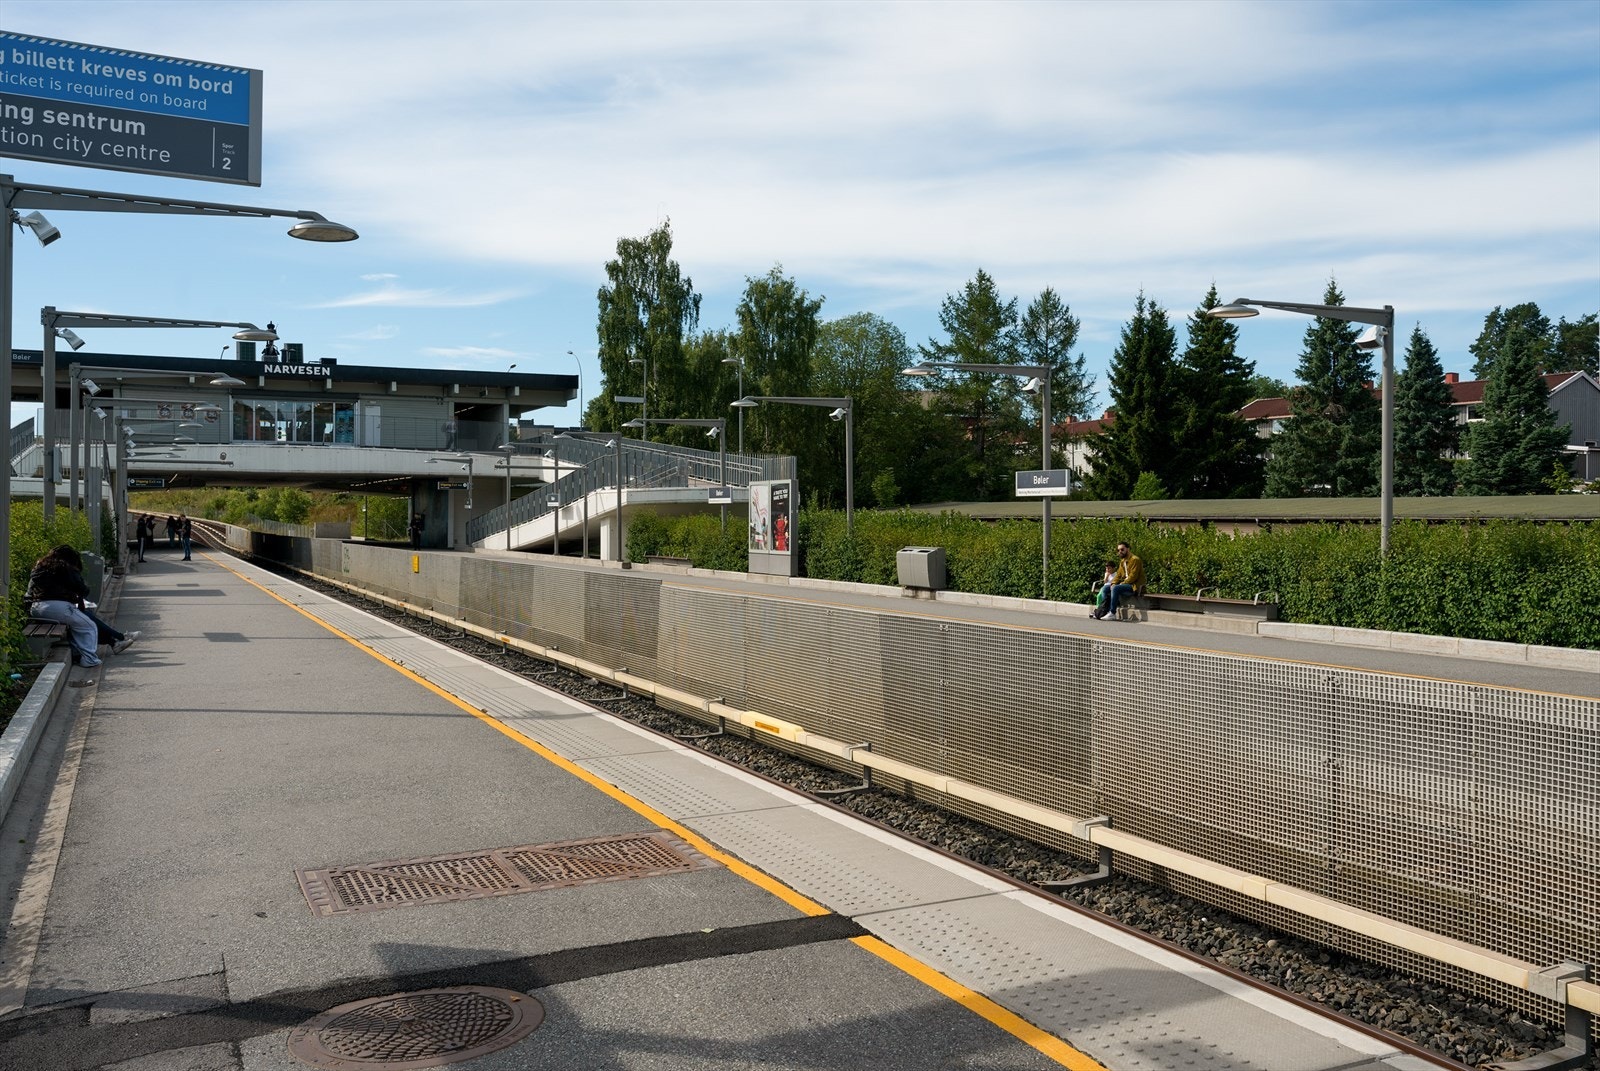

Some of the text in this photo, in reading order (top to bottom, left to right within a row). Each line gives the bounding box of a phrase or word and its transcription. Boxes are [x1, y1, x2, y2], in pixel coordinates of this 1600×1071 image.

[12, 48, 75, 72] billett
[81, 59, 147, 82] kreves
[153, 72, 182, 88] om
[188, 74, 233, 94] bord
[0, 70, 207, 111] ticket is required on board
[42, 109, 146, 136] sentrum
[1, 126, 170, 163] tion city centre
[222, 157, 231, 170] 2
[264, 364, 331, 376] NARVESEN
